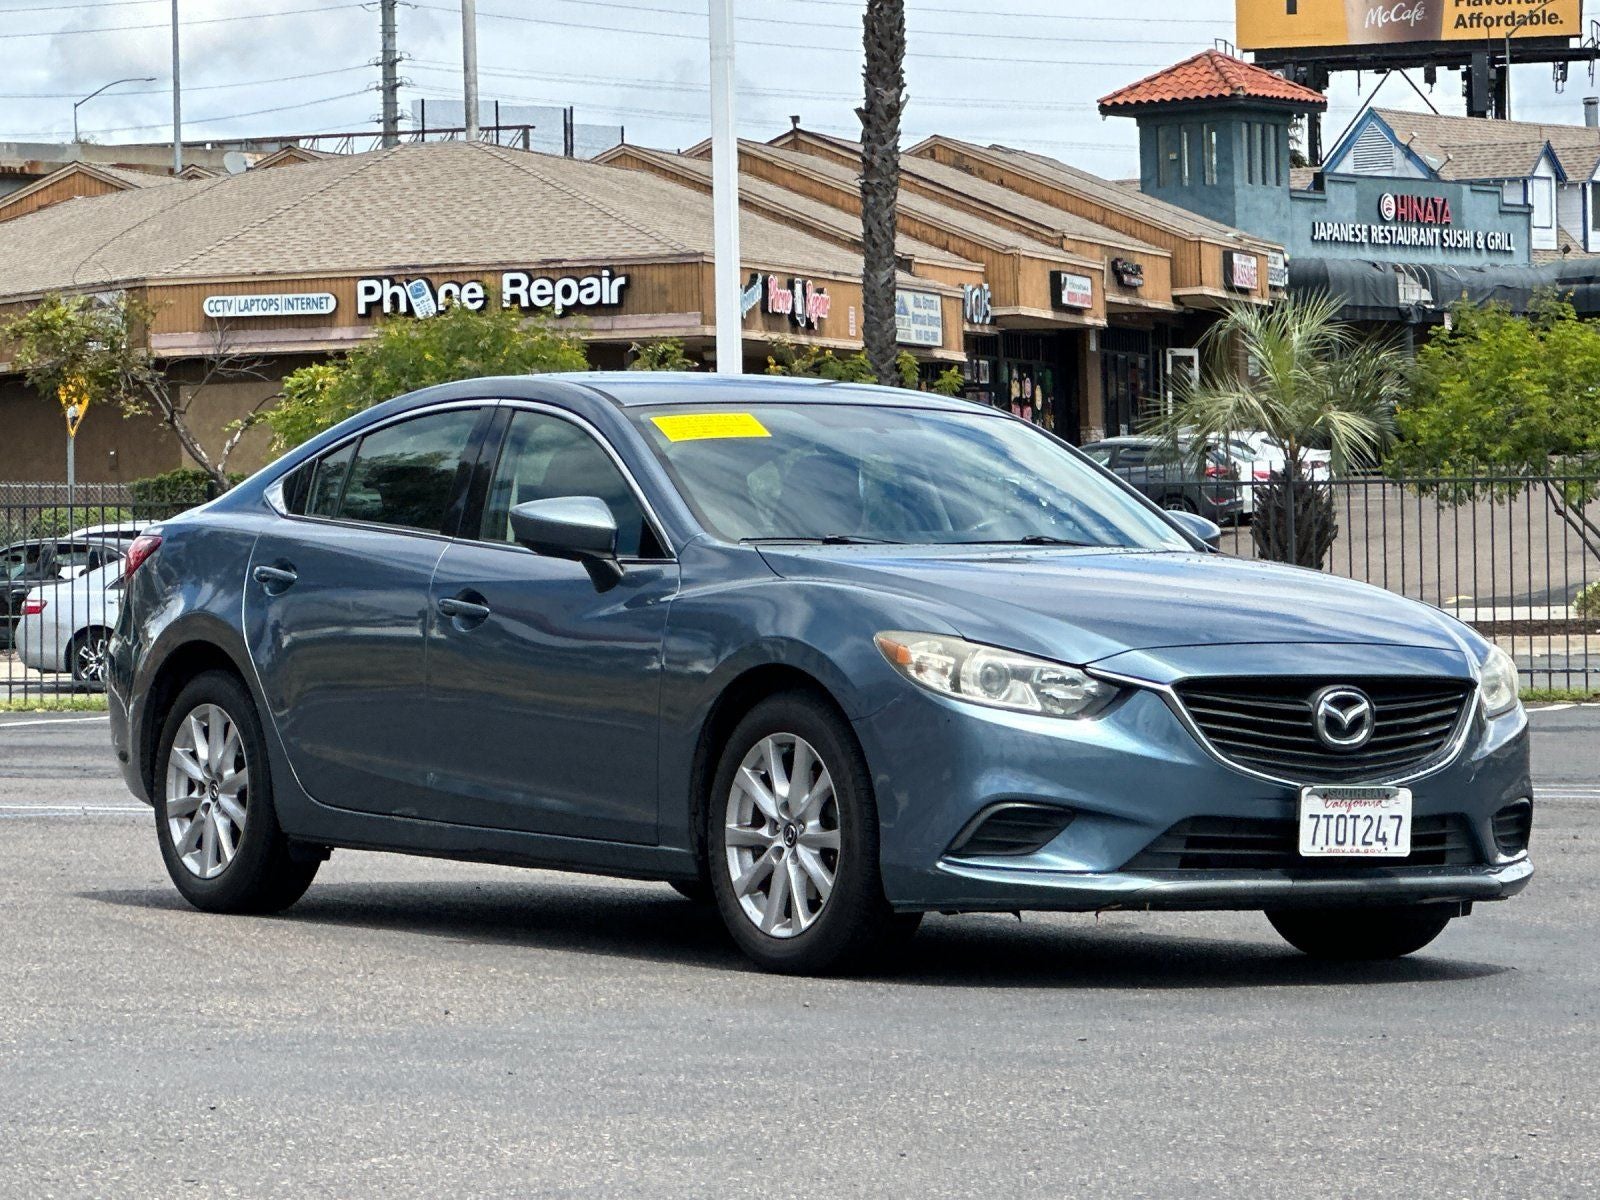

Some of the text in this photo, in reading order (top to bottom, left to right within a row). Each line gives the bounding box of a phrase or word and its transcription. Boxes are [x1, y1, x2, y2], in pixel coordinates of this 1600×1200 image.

[1364, 1, 1425, 28] McCafé
[1454, 9, 1564, 29] Affordable.
[1395, 195, 1452, 224] HINATA
[1313, 222, 1516, 251] JAPANESE RESTAURANT SUSHI & GRILL
[207, 296, 331, 313] CCTV LAPTOPS INTERNET
[502, 269, 626, 315] Repair
[1323, 798, 1384, 813] California
[1308, 813, 1403, 846] 7TOT247
